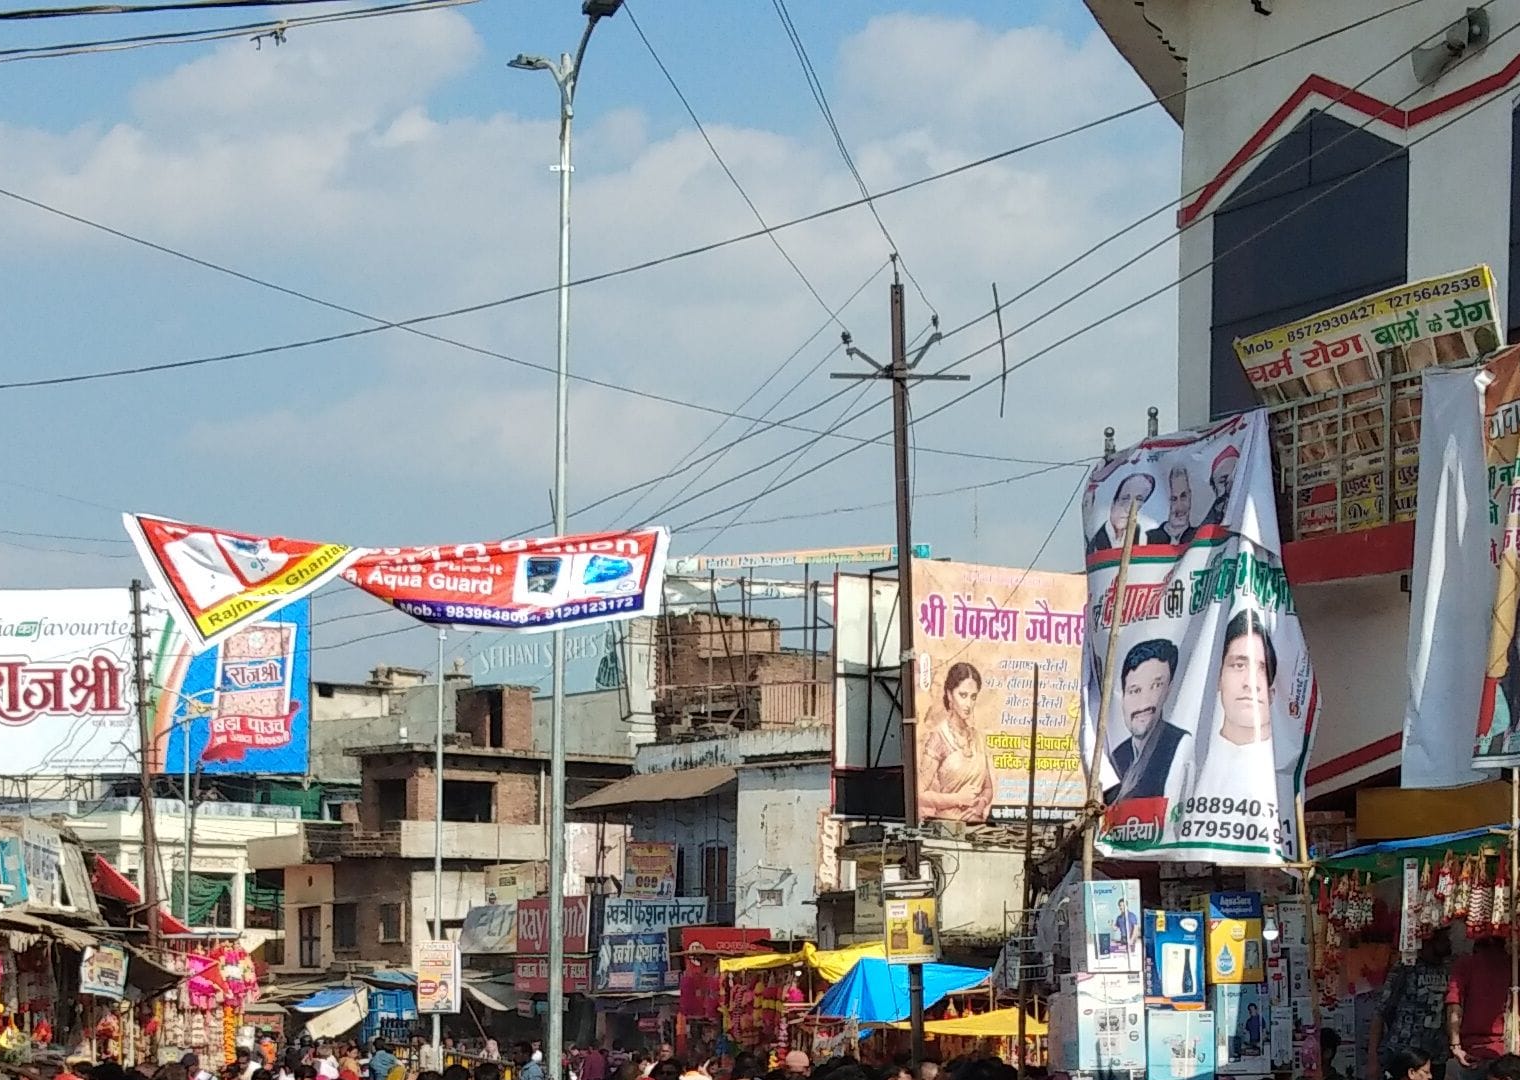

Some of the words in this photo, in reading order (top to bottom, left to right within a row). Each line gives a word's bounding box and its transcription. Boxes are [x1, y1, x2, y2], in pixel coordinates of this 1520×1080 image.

[1303, 333, 1364, 369] रोग
[1371, 309, 1420, 346] बालों
[1426, 313, 1443, 333] के
[1445, 298, 1495, 329] रोग
[1243, 339, 1274, 356] Mob
[367, 571, 422, 592] Aqua
[429, 574, 493, 596] Guard
[32, 617, 129, 642] favourite
[920, 595, 947, 638] श्री
[954, 595, 1018, 643] वेंकटेश
[480, 642, 541, 676] SETHANI
[230, 661, 280, 686] राजश्री
[986, 732, 1022, 750] धनतेरस
[606, 901, 634, 926] खत्री
